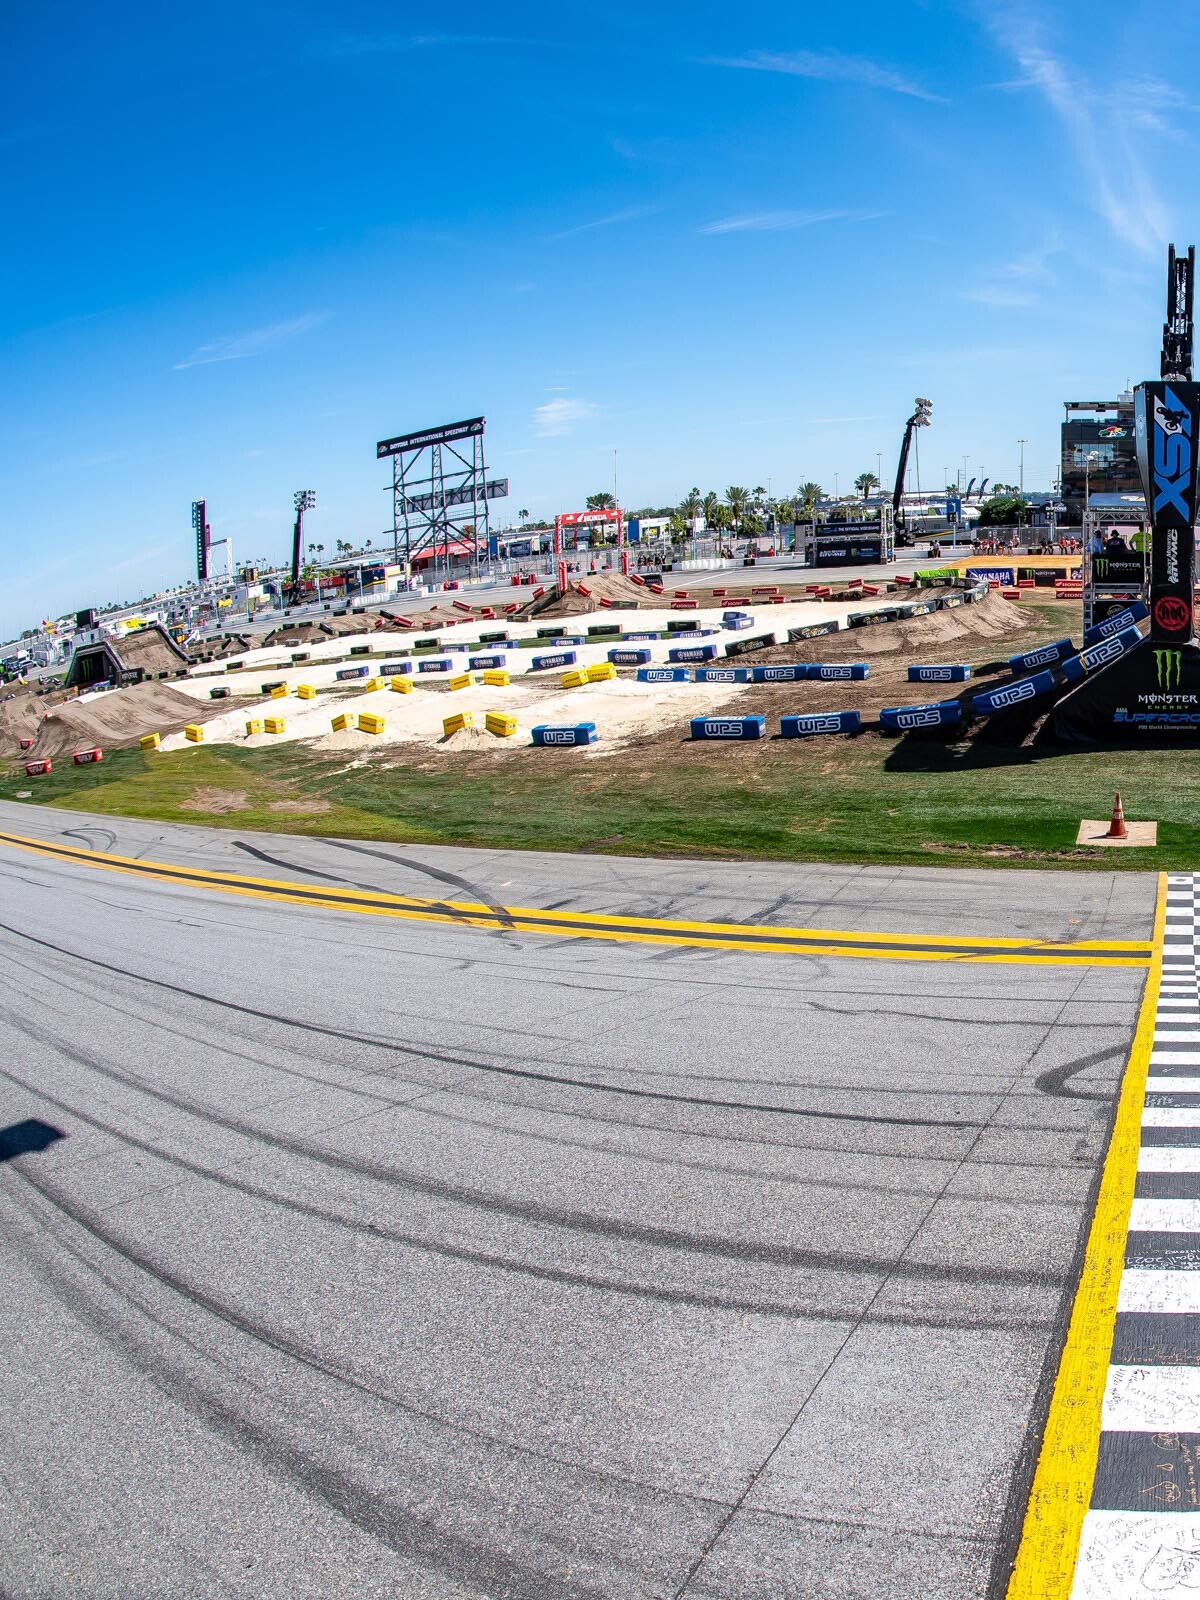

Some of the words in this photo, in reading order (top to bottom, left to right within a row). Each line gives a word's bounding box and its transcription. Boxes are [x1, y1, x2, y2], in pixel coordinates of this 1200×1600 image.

[390, 441, 408, 450] DAYTONA
[409, 432, 443, 445] INTERNATIONAL
[444, 426, 468, 437] SPEEDWAY
[977, 571, 1011, 581] YAMAHA
[1099, 613, 1135, 638] WPS
[1023, 648, 1060, 668] WPS
[1080, 639, 1124, 670] WPS
[647, 669, 675, 682] WPS
[705, 669, 734, 682] WPS
[764, 667, 795, 680] WPS
[820, 666, 851, 680] WPS
[920, 668, 951, 681] WPS
[990, 683, 1035, 709] WPS
[1138, 693, 1198, 704] MONSTER
[798, 716, 841, 733] WPS
[898, 710, 942, 729] WPS
[704, 722, 744, 737] WPS
[543, 730, 575, 745] WPS
